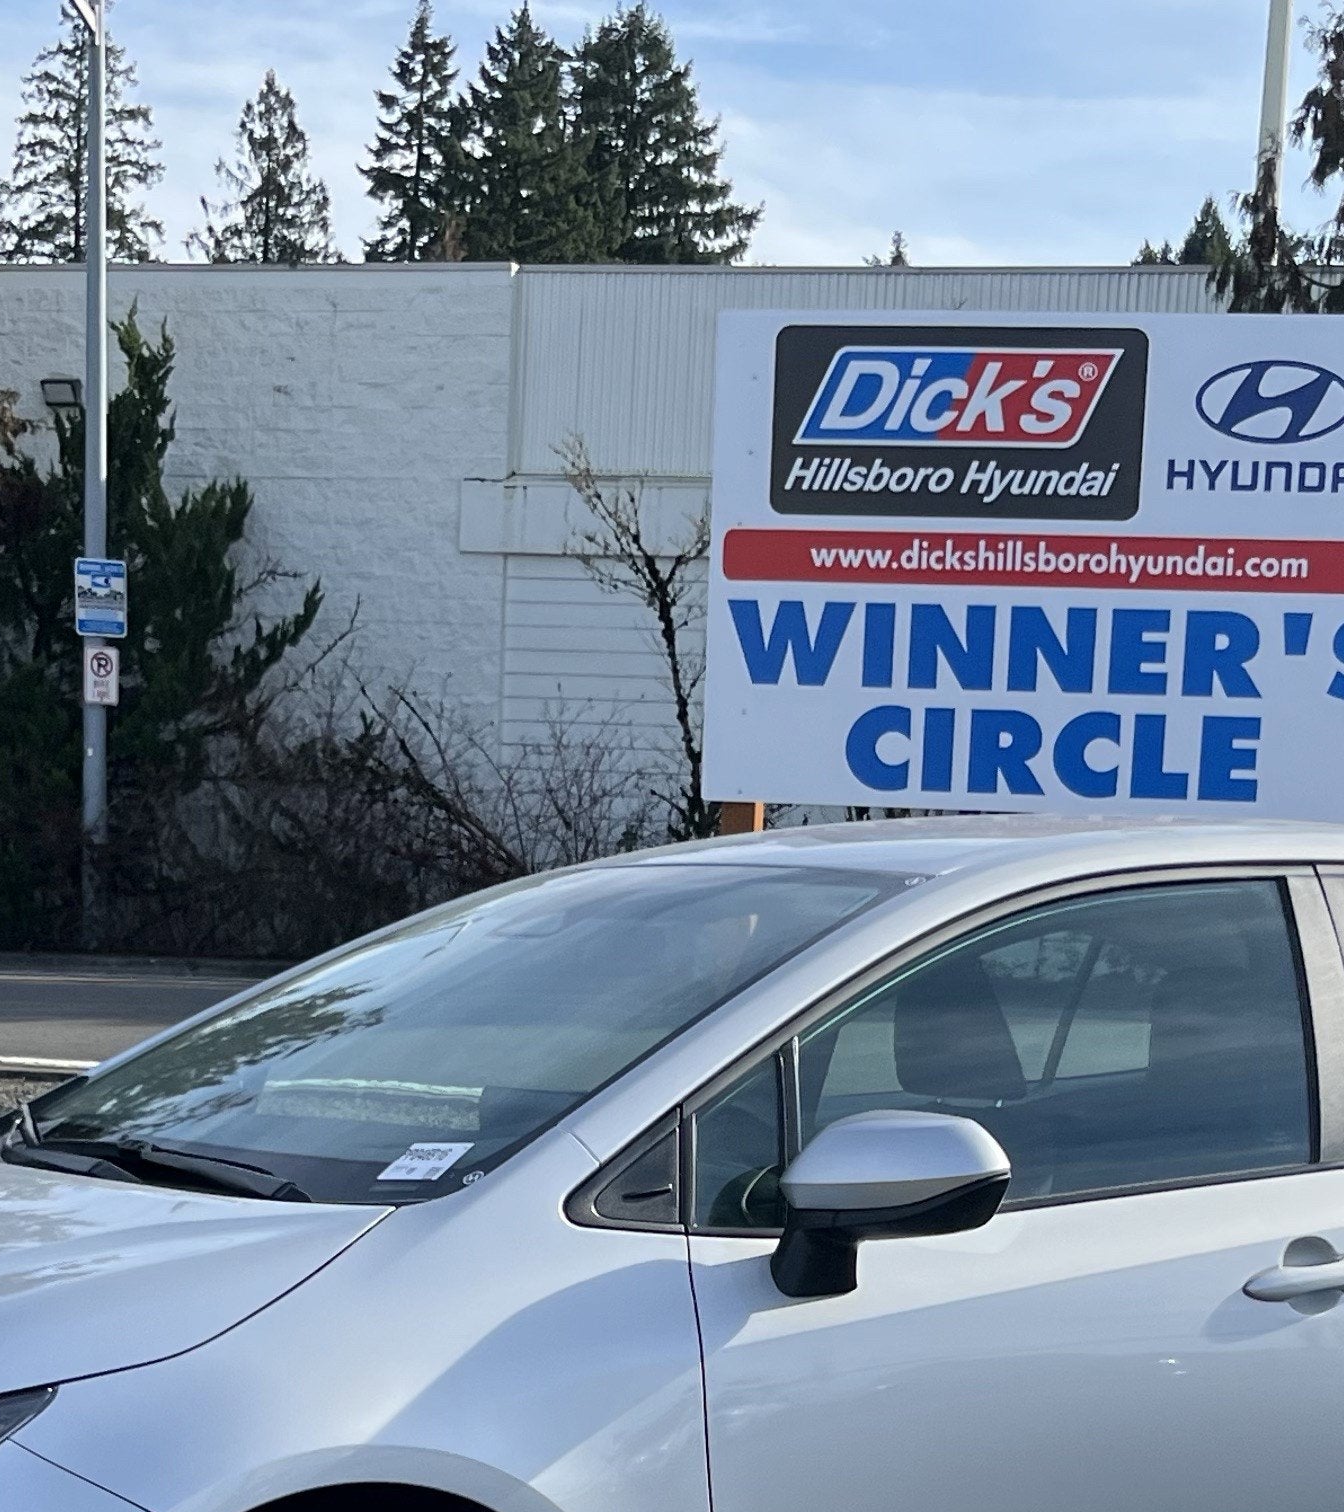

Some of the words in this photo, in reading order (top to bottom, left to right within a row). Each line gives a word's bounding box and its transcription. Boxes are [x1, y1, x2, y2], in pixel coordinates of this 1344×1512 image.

[819, 358, 1081, 434] Dick's
[784, 457, 954, 493] Hillsboro
[960, 460, 1120, 503] Hyundai
[810, 538, 1309, 583] www.dickshillsborohyundai.com
[845, 706, 1262, 802] CIRCLE
